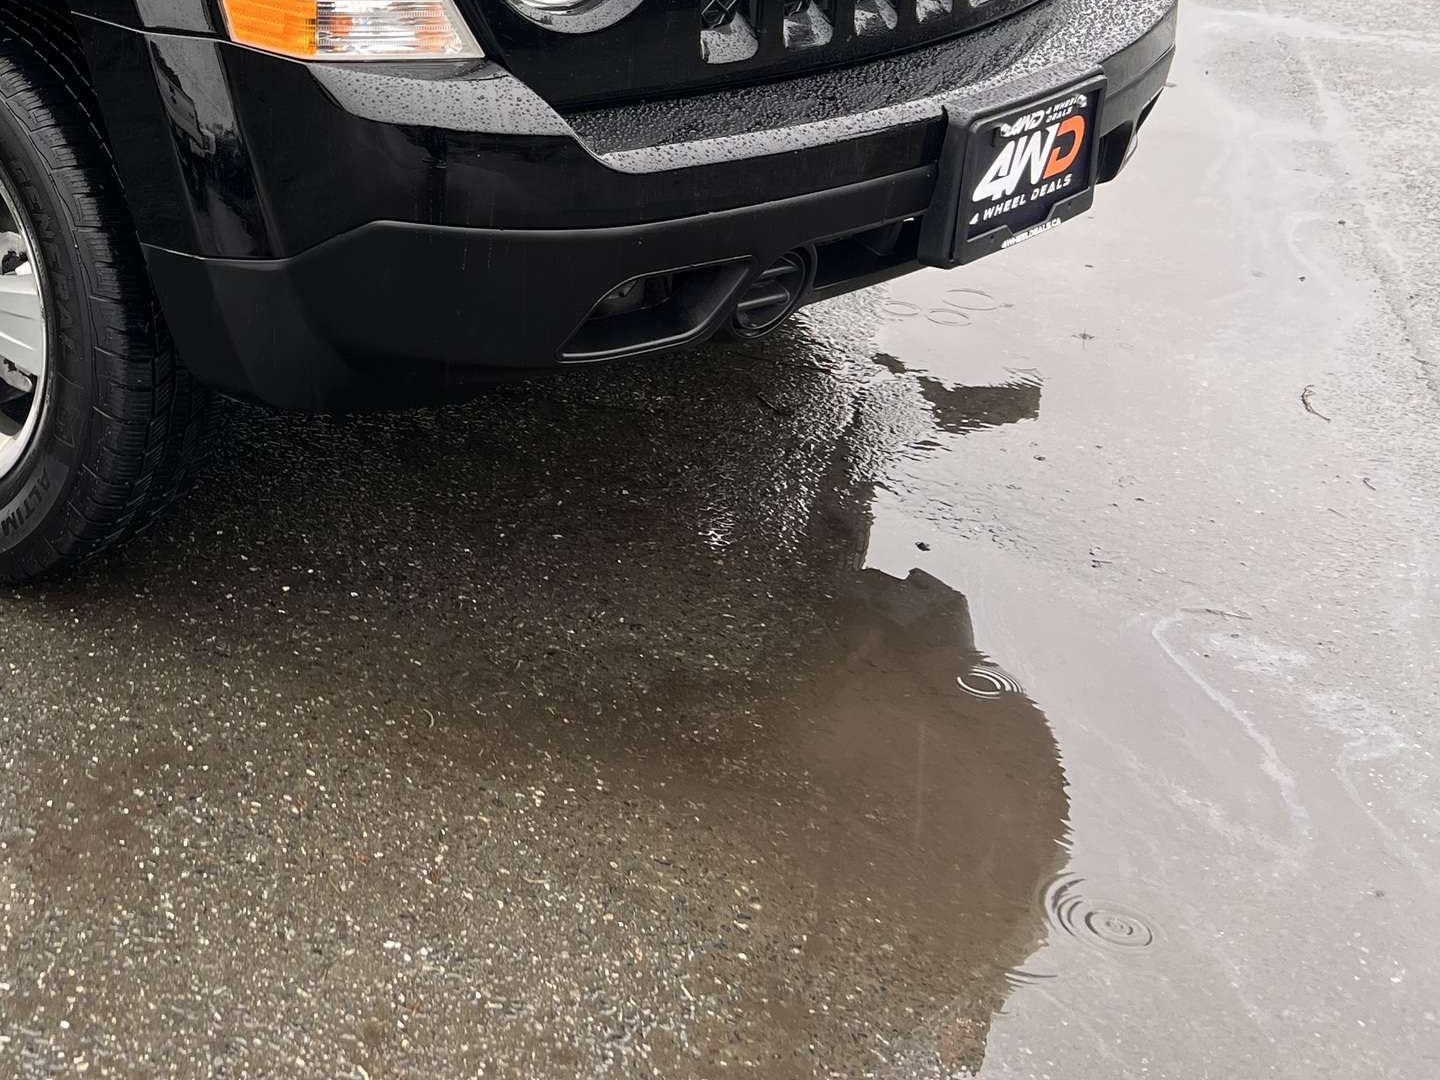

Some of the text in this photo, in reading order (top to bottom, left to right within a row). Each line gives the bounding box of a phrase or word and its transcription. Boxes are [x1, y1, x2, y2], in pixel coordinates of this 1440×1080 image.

[972, 114, 1086, 203] 4WD
[983, 193, 1027, 221] WHEEL
[1030, 173, 1073, 201] DEALS
